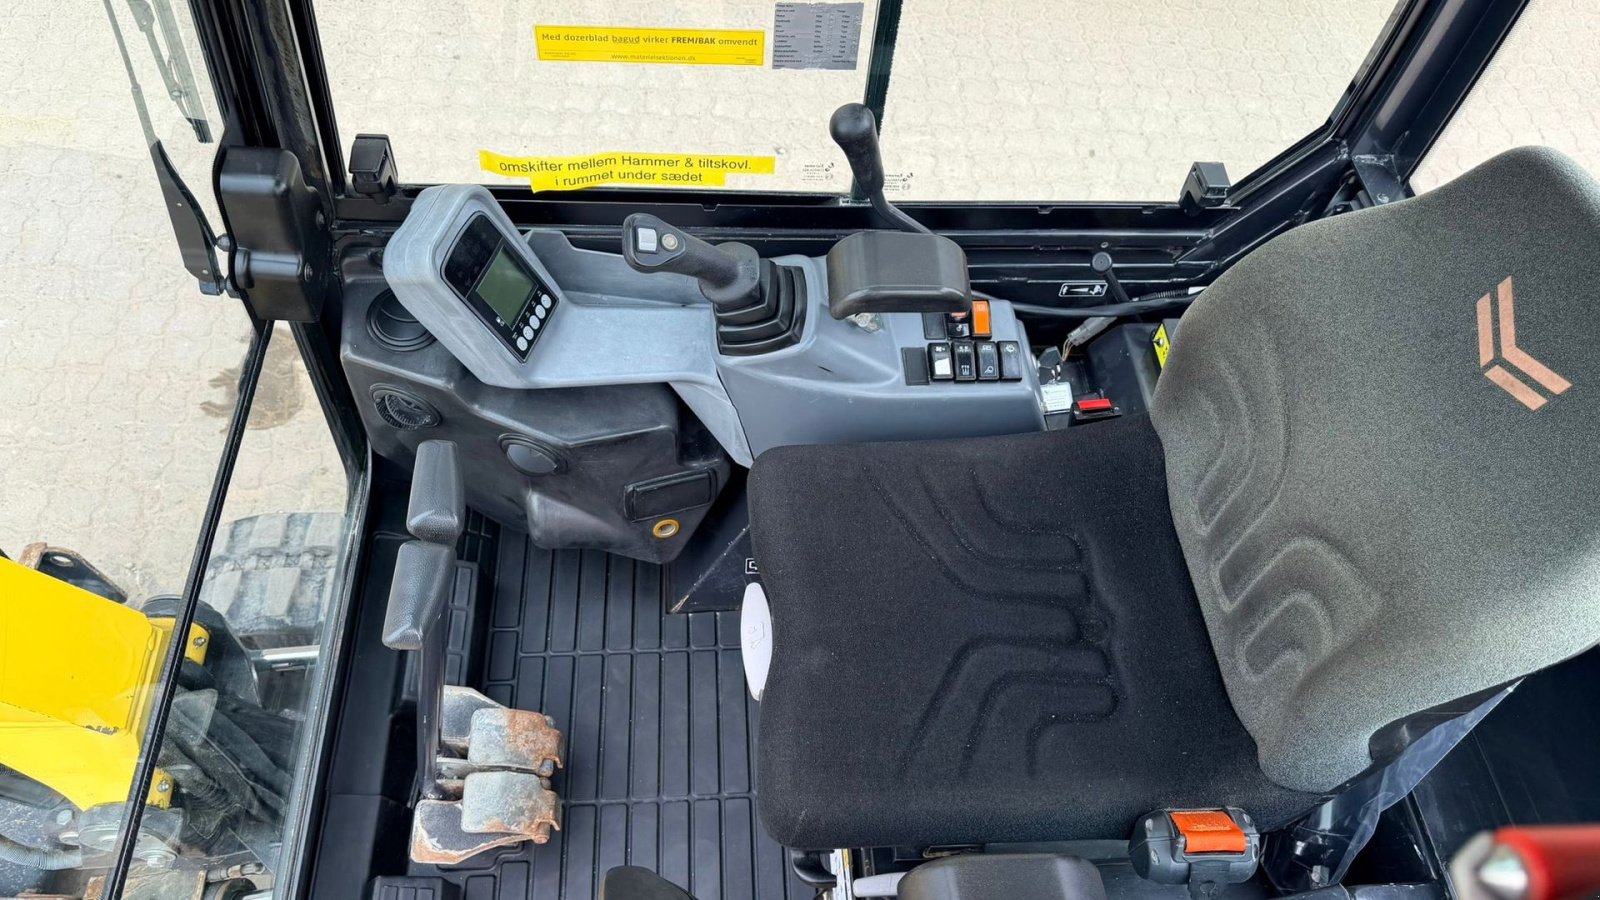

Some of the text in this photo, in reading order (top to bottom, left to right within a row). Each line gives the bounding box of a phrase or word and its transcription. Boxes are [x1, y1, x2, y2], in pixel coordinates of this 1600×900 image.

[542, 33, 757, 46] Med dozerblad bagud virker FREM/BAK omvendt
[499, 155, 751, 172] omskifter mellem Hammer & tiltskovl.
[555, 170, 703, 186] i rummet under sædet
